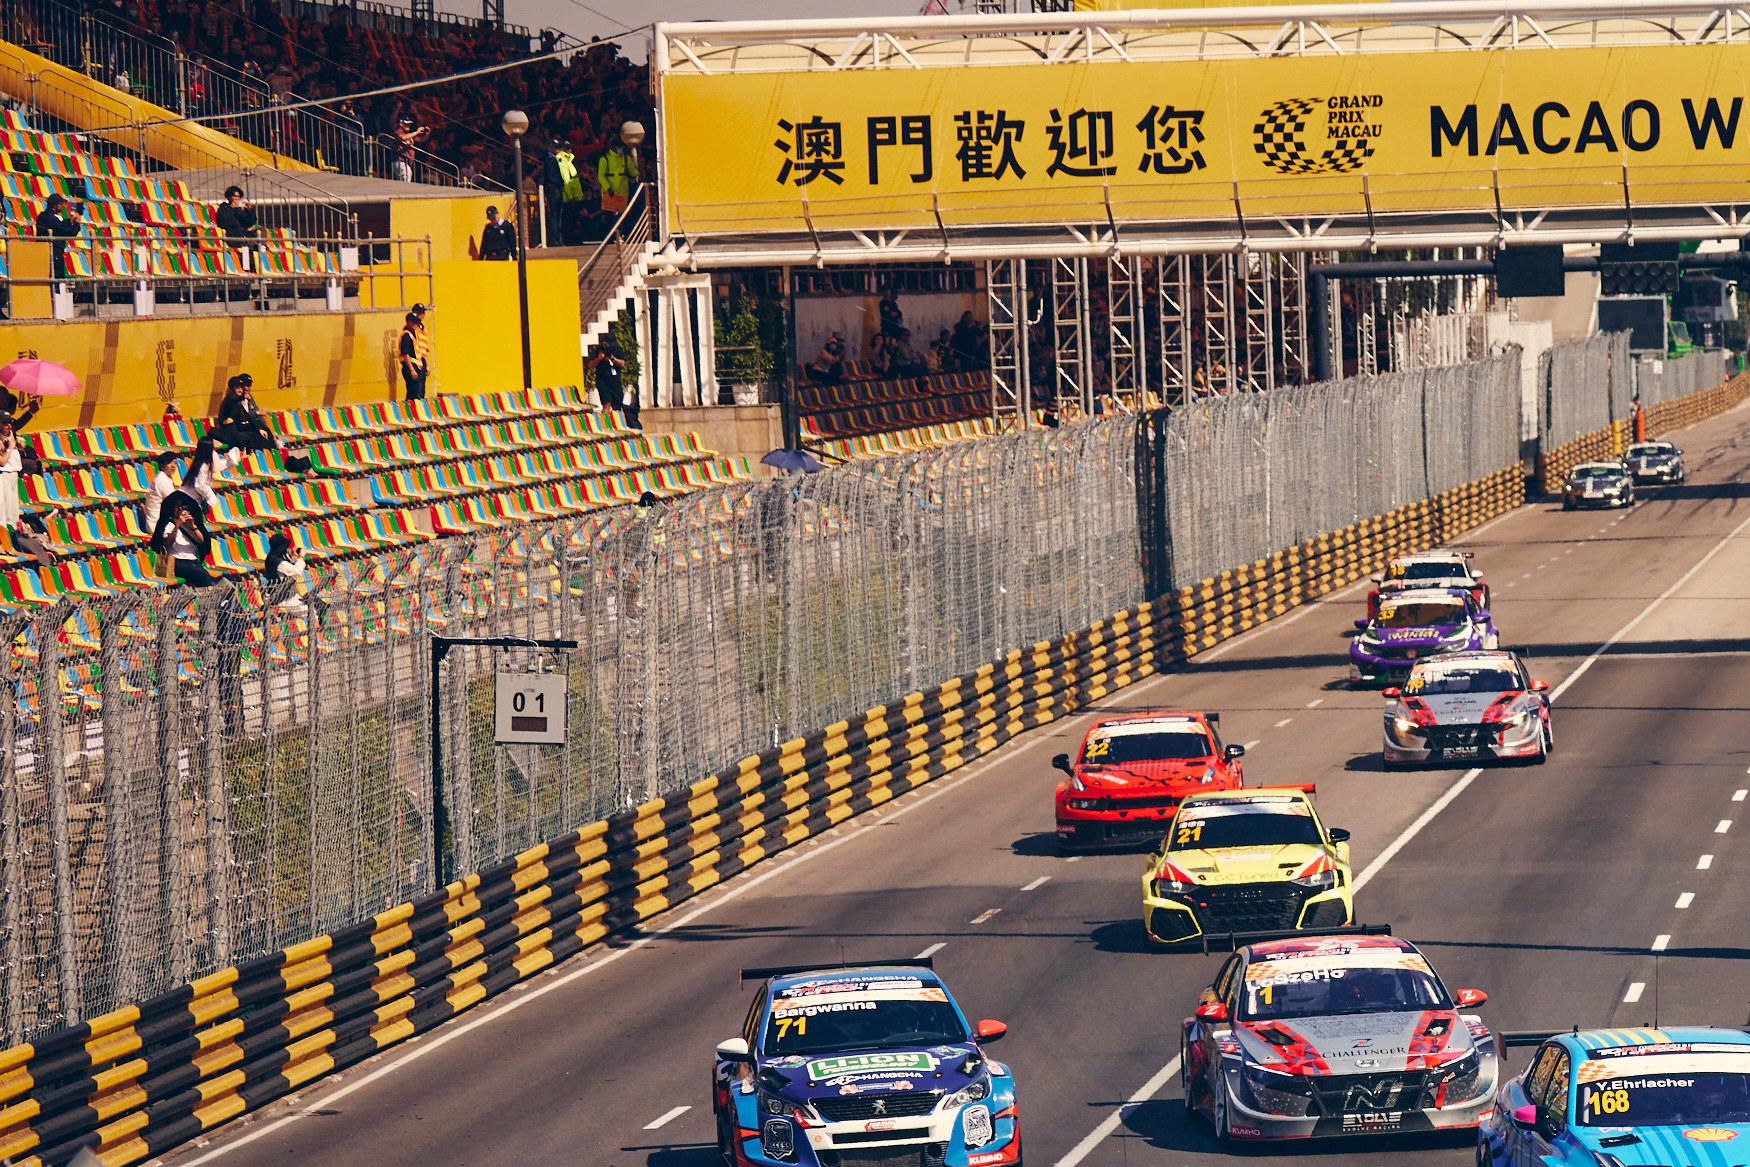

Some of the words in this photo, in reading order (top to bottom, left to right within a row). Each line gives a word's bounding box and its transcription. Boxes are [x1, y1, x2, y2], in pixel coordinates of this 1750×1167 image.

[1328, 95, 1383, 109] GRAND
[1328, 111, 1364, 123] PRIX
[1327, 125, 1382, 138] MACAU
[1431, 99, 1660, 157] MACAO
[774, 105, 1208, 187] 澳門歡迎您
[1086, 742, 1110, 758] 22
[1177, 826, 1202, 844] 21
[1259, 984, 1273, 1005] 1
[775, 1001, 877, 1019] Bargwanna
[775, 1017, 807, 1038] 71
[1322, 1047, 1407, 1058] CHALLENGER
[1596, 1078, 1695, 1091] Y.Ehrlacher
[1589, 1089, 1630, 1116] 168
[968, 1153, 1004, 1166] KUMHO
